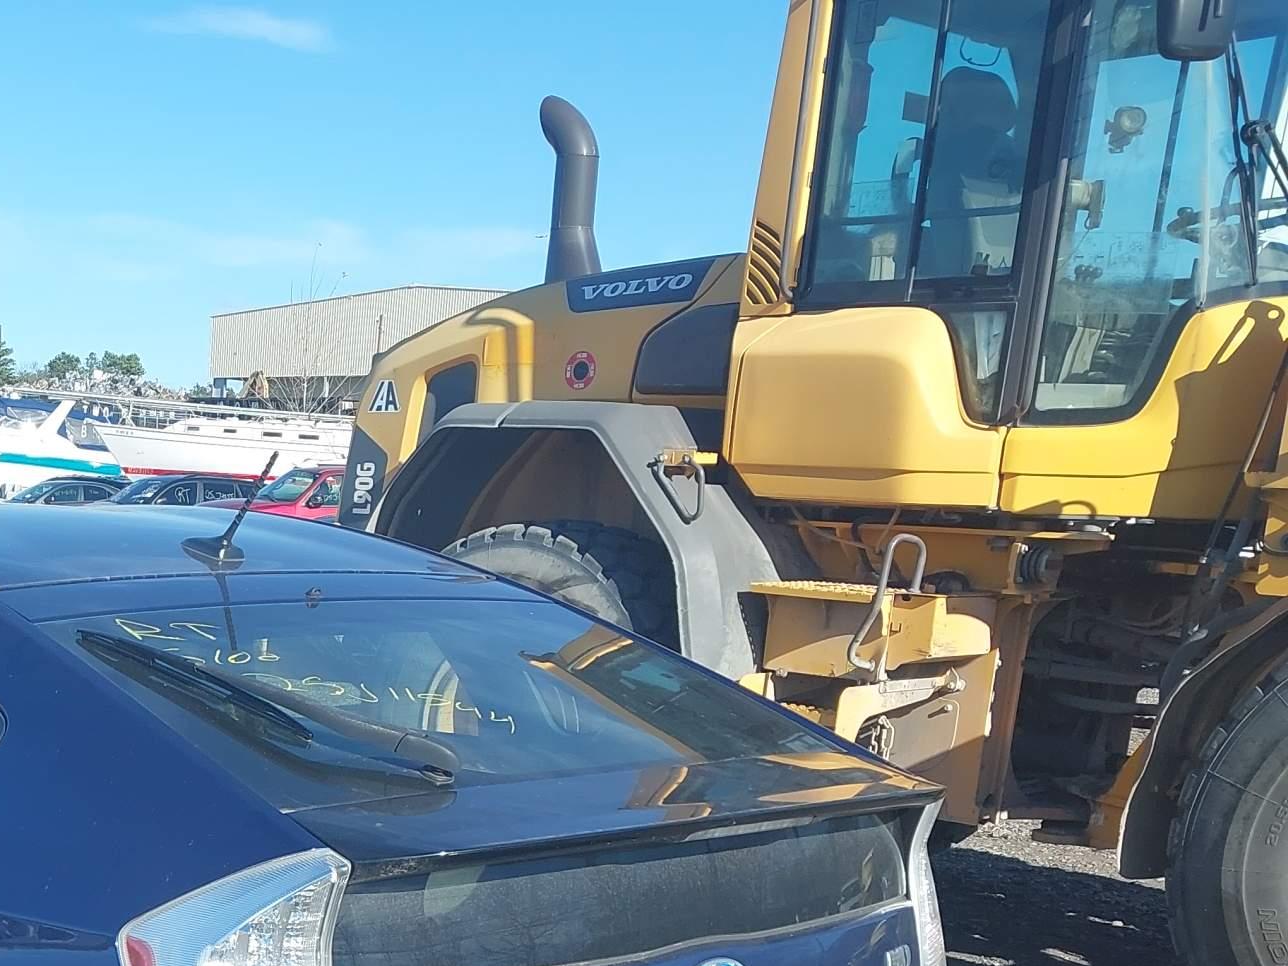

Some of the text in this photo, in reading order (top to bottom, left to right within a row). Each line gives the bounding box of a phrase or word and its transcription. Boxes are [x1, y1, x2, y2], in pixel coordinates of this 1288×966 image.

[581, 273, 693, 300] VOLVO
[352, 462, 376, 515] L90G
[115, 618, 222, 641] RT
